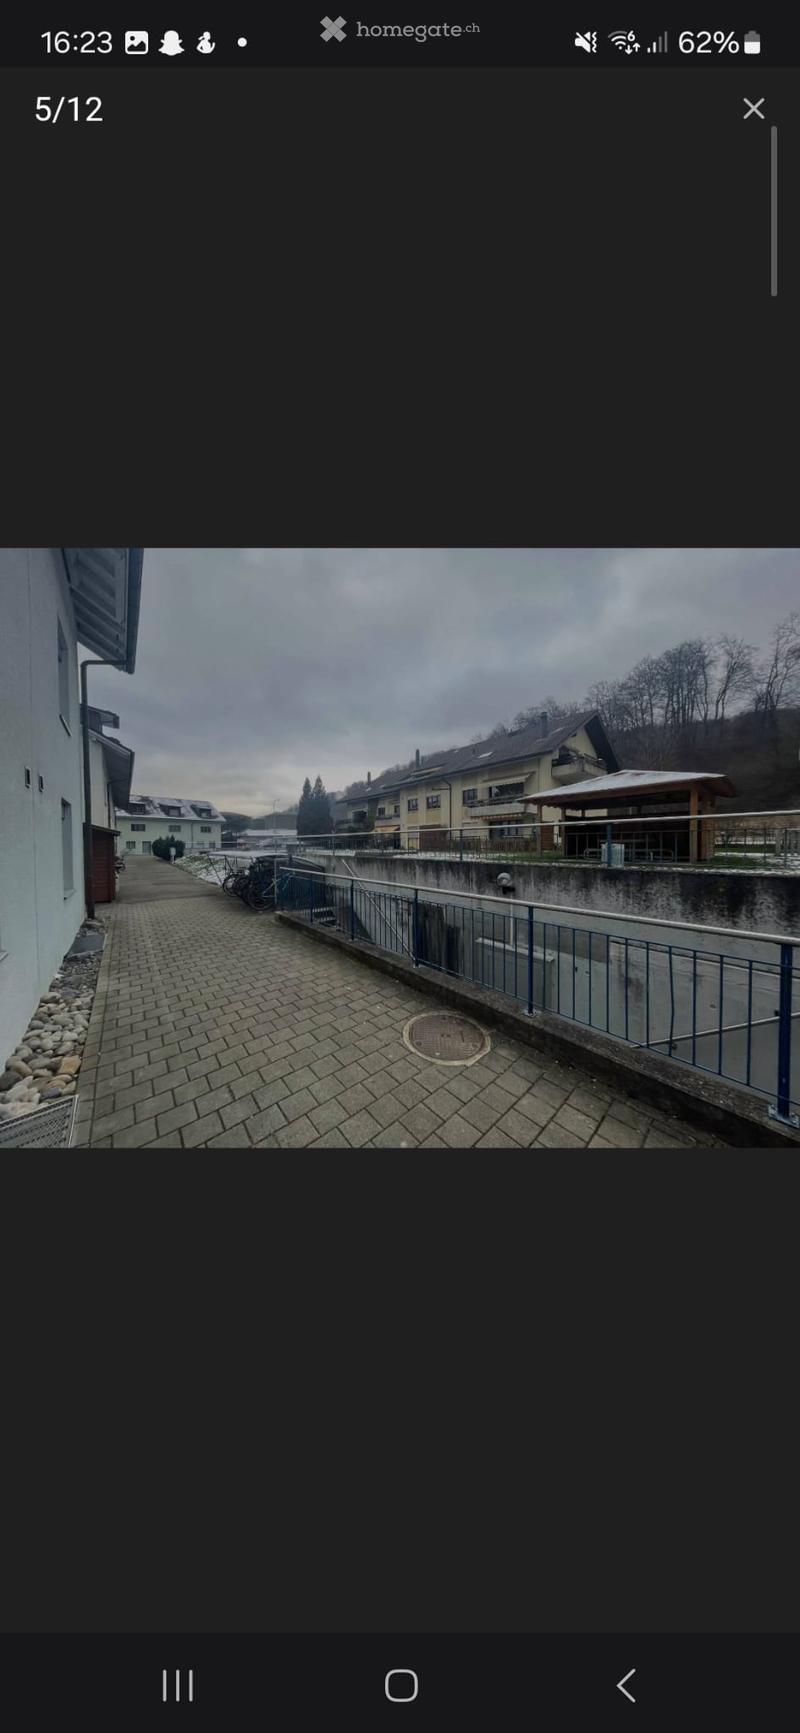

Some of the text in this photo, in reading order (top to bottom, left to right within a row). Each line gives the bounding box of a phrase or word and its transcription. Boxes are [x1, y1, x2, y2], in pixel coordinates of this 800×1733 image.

[41, 31, 113, 54] 16:23
[356, 21, 481, 43] homegate.ch
[678, 31, 740, 54] 62%
[35, 96, 104, 124] 5/12
